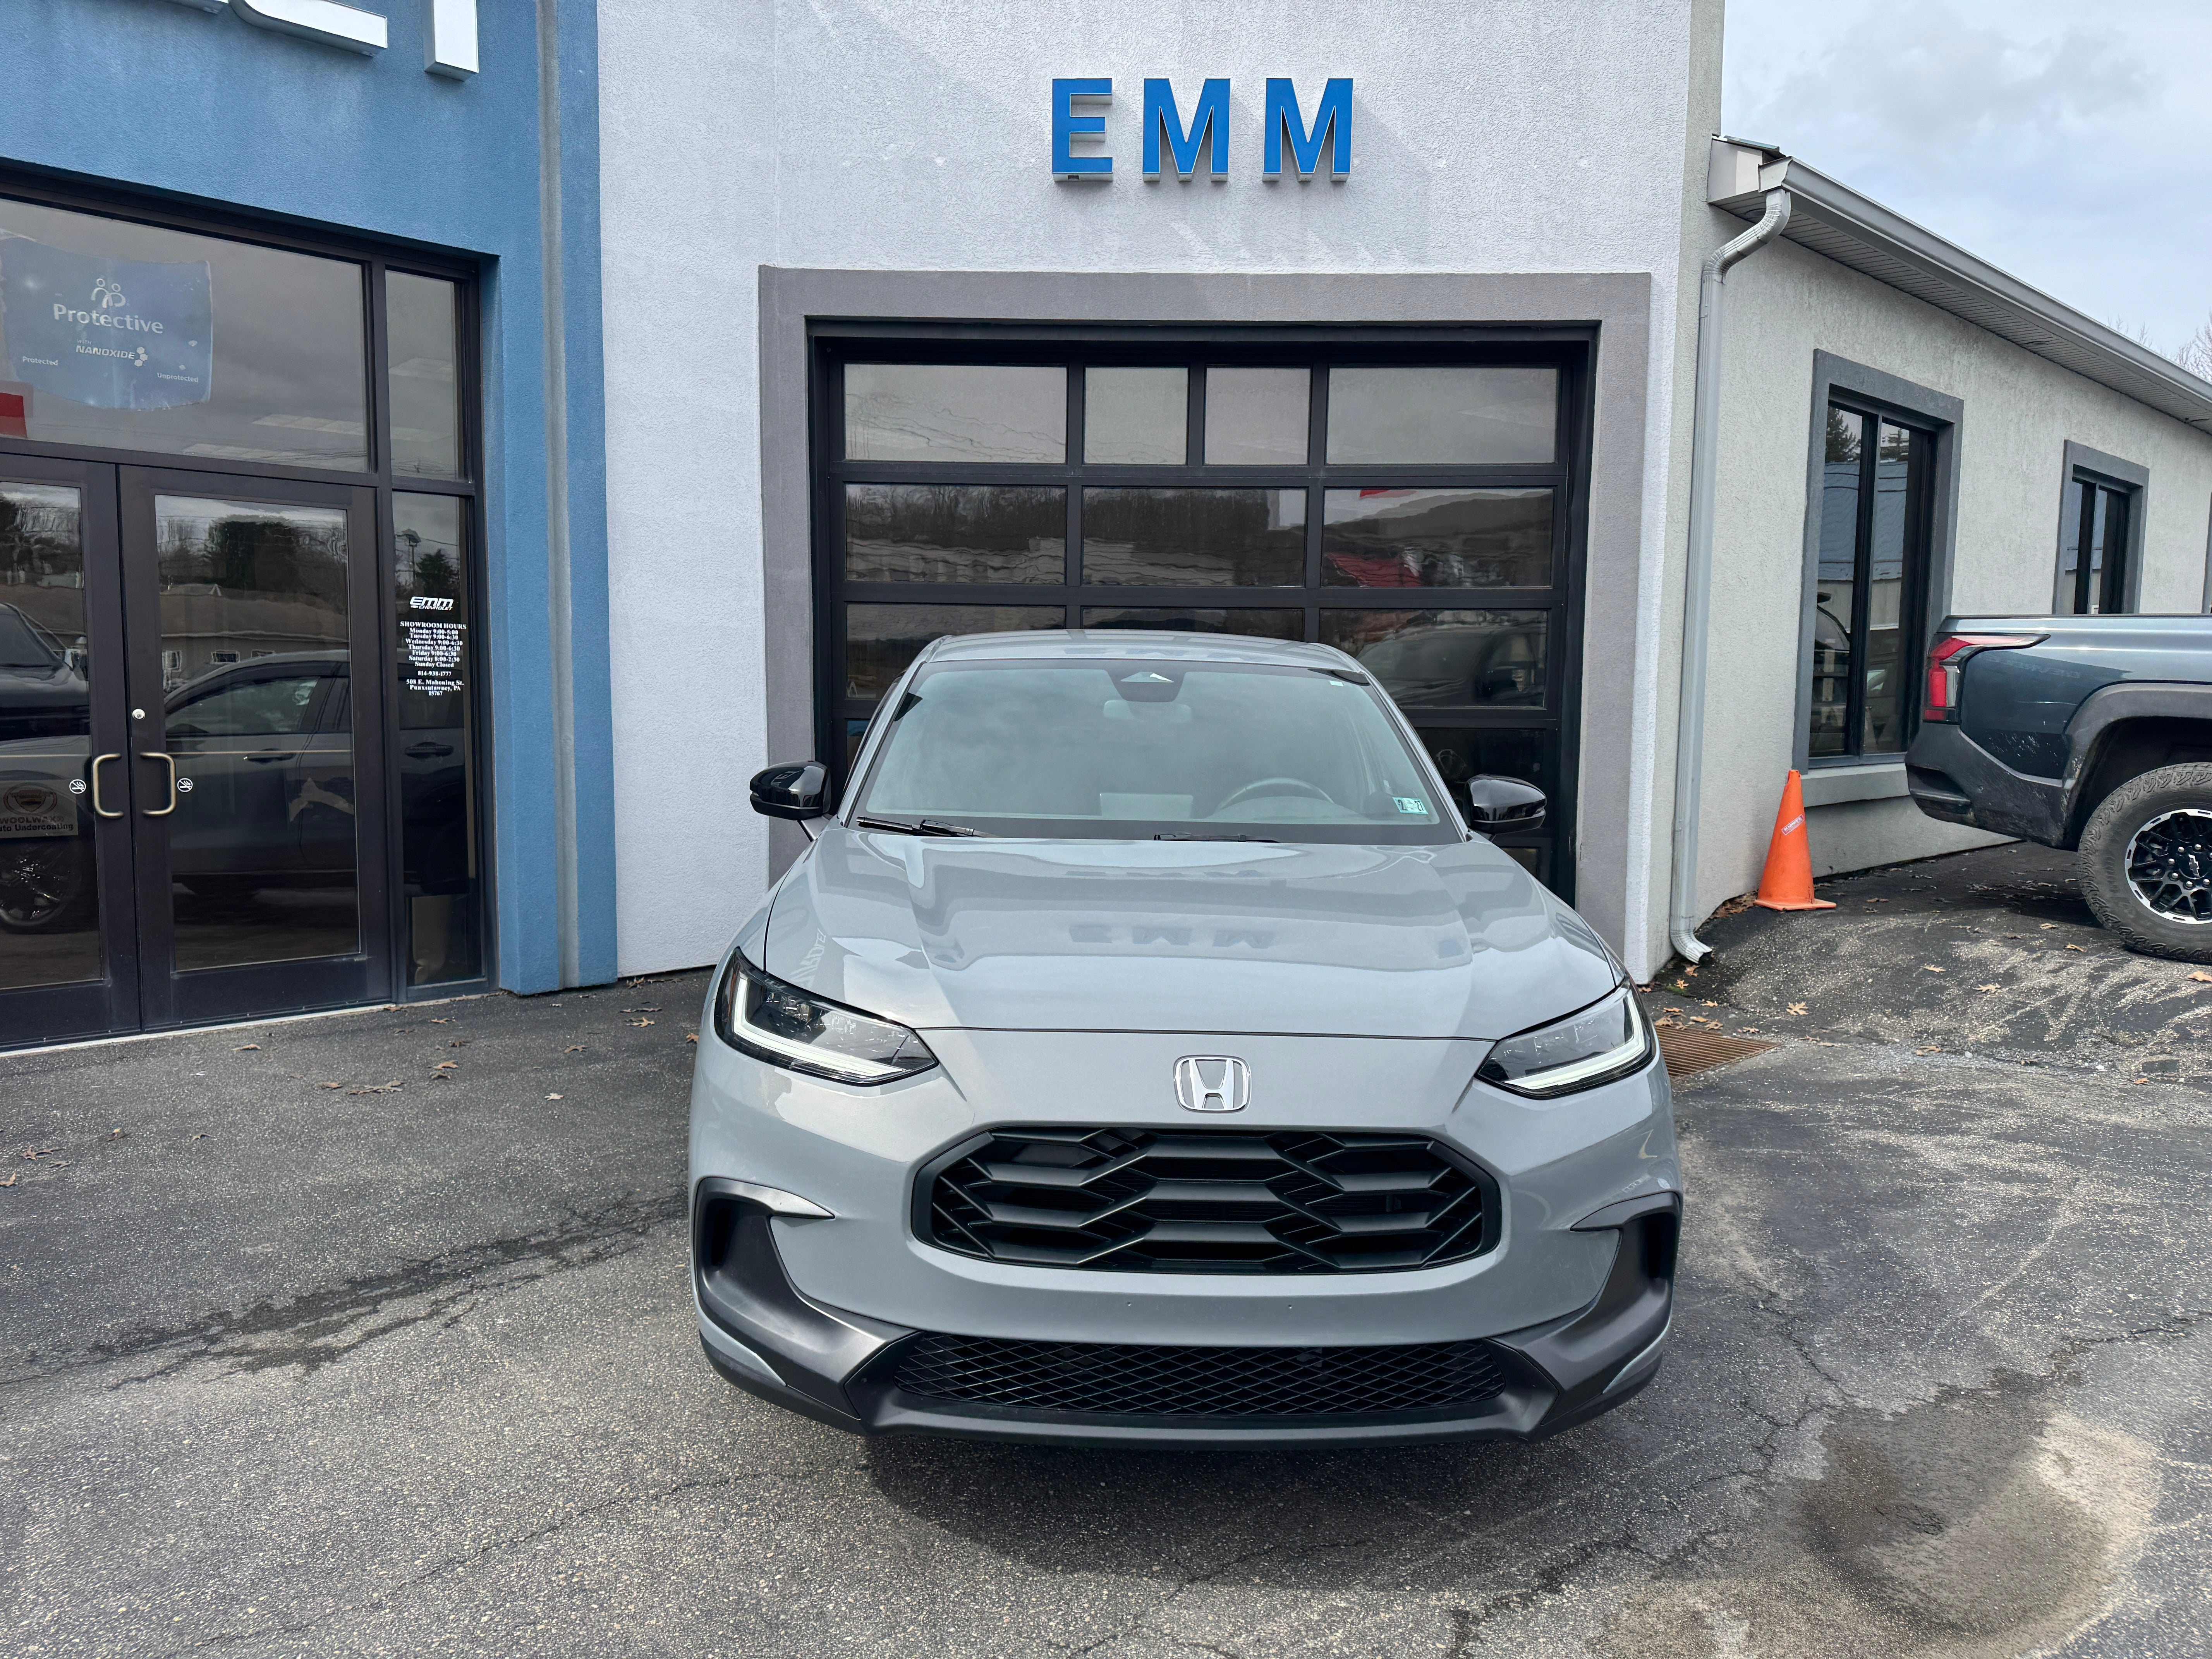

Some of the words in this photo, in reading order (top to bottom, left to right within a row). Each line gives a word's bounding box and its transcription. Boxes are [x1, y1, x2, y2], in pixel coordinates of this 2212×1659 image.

[1052, 78, 1353, 180] EMM
[53, 304, 163, 334] Protective
[76, 345, 135, 359] NANOXIDE
[22, 356, 58, 366] Protected
[157, 373, 199, 382] Unprotected
[1414, 800, 1424, 811] 27
